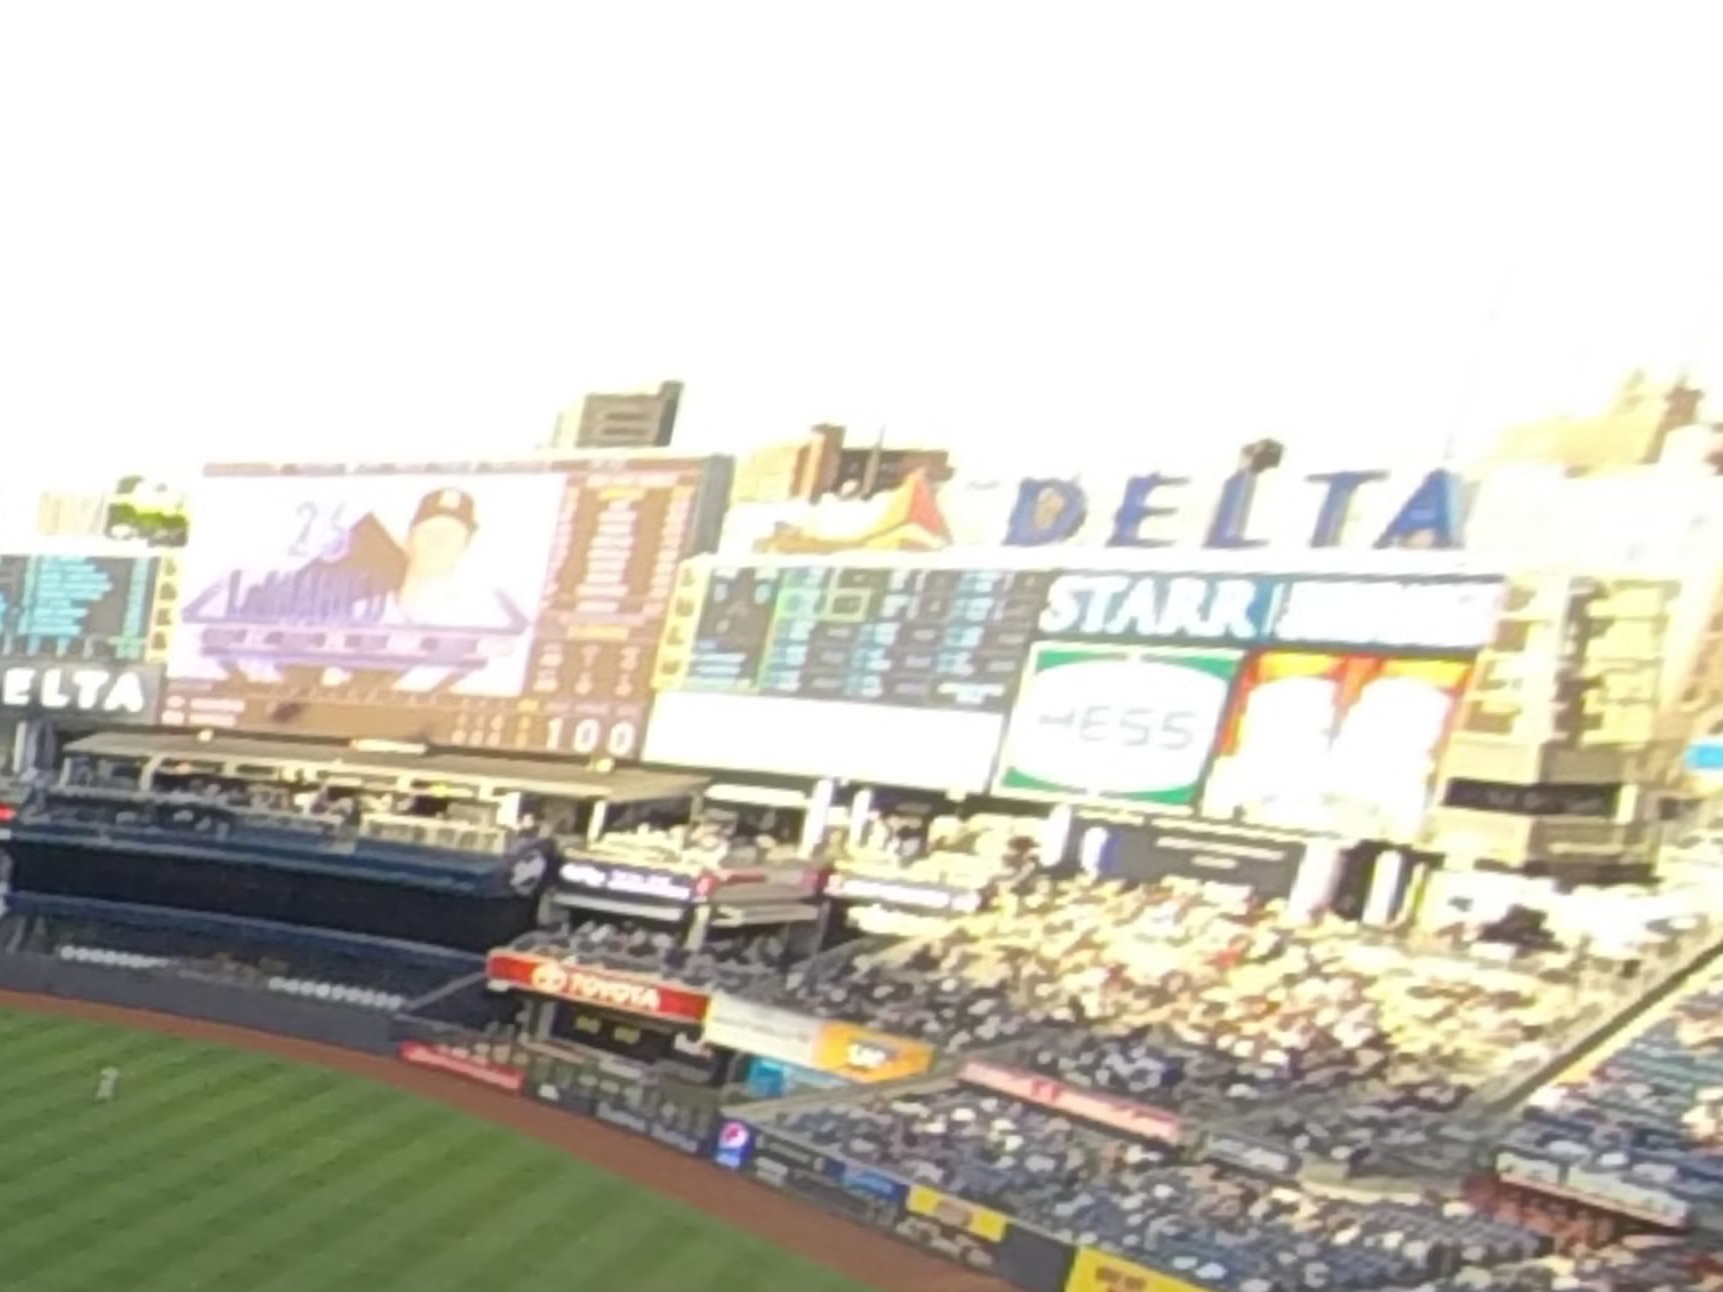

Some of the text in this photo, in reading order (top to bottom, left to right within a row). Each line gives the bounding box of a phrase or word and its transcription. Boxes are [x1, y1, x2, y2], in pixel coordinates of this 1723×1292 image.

[1001, 468, 1466, 549] DELTA
[1038, 574, 1257, 639] STARR
[569, 971, 661, 1011] TOYOTA
